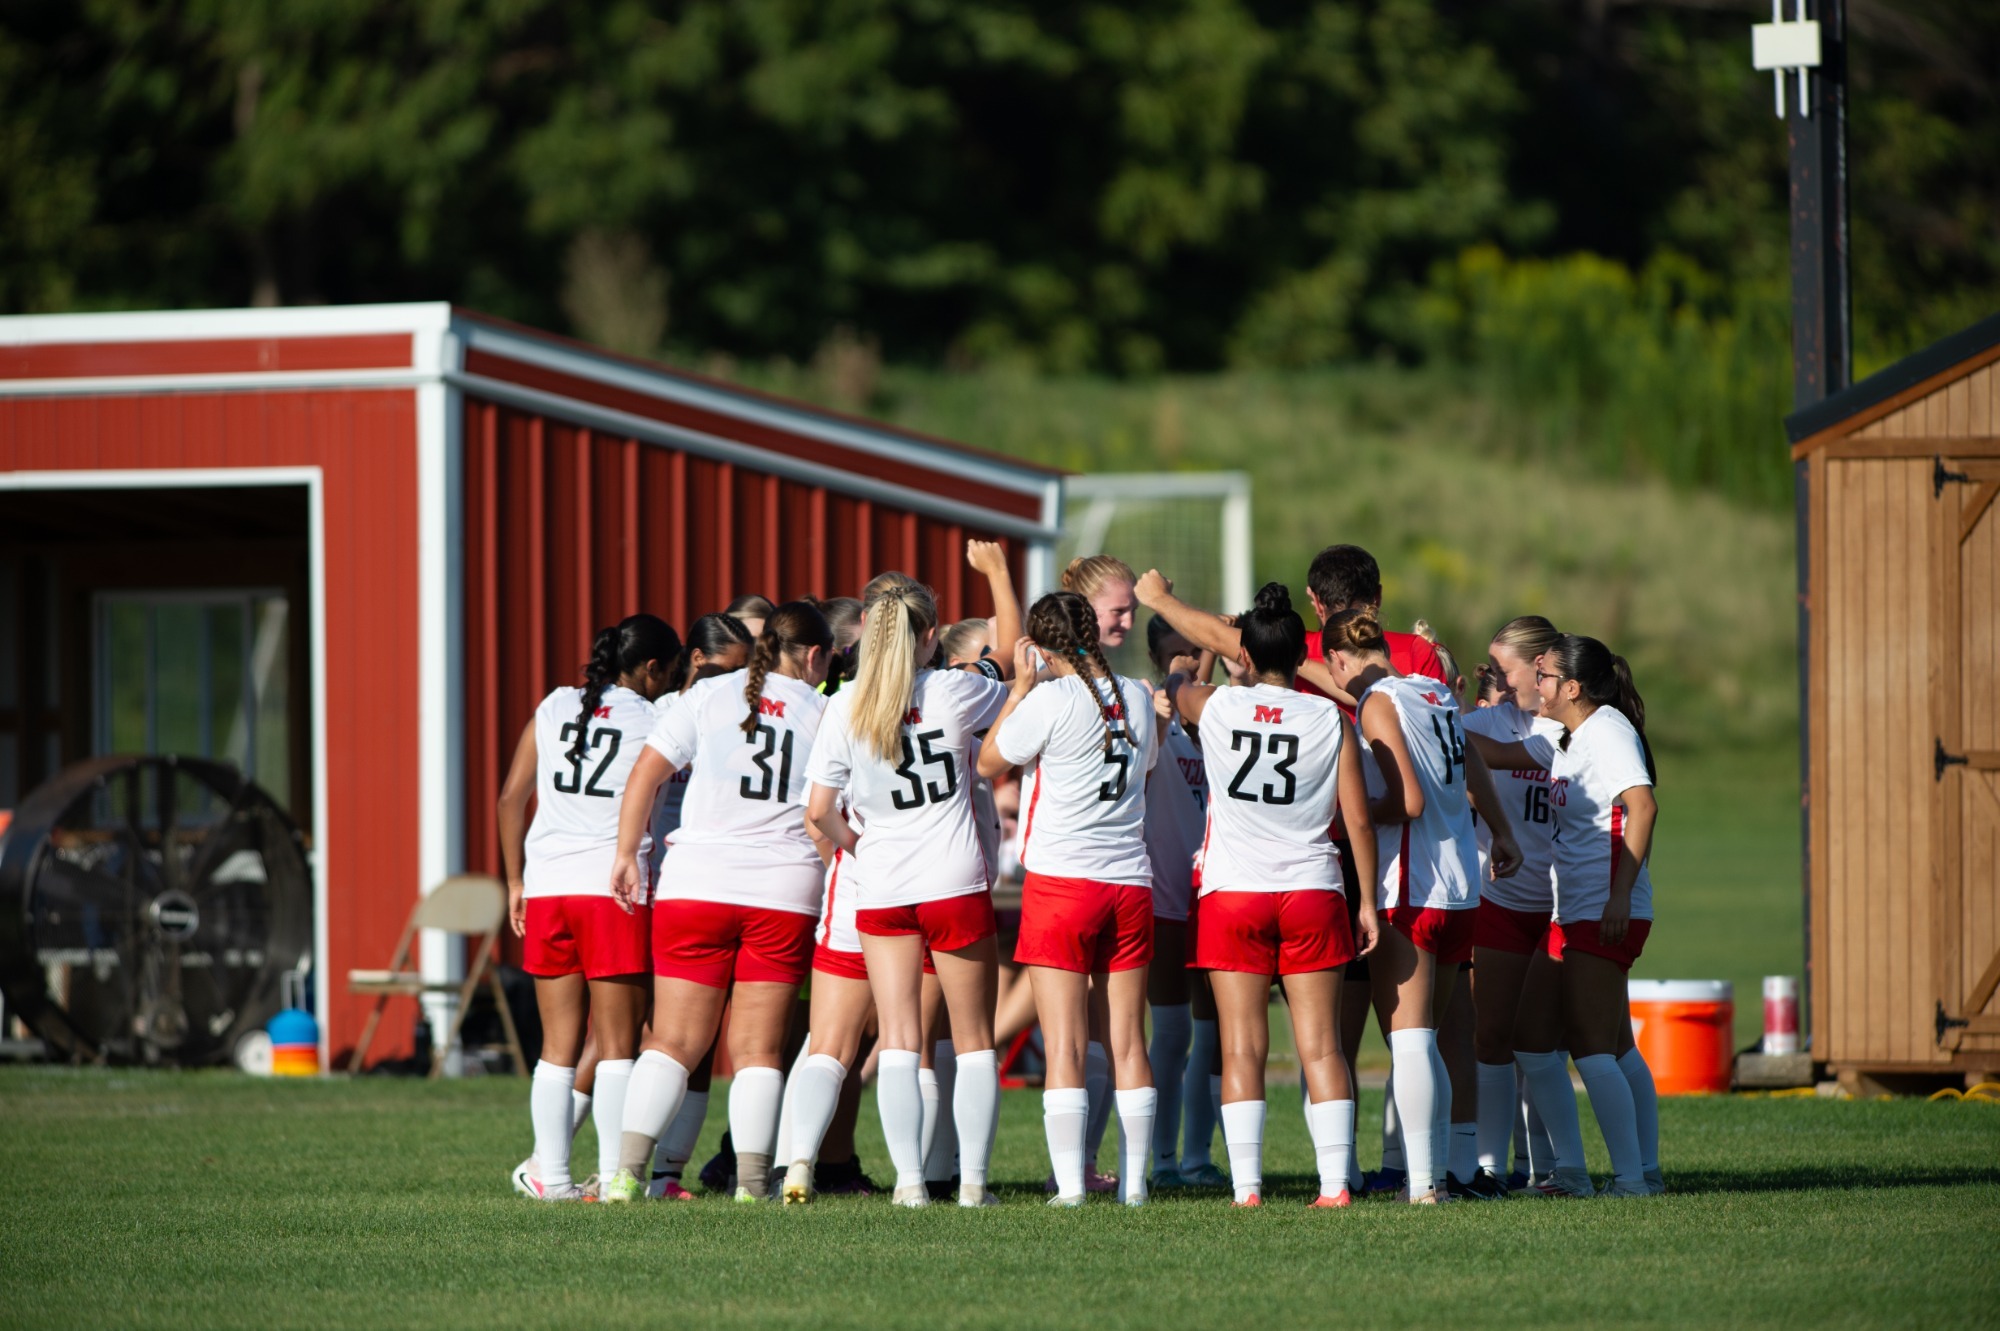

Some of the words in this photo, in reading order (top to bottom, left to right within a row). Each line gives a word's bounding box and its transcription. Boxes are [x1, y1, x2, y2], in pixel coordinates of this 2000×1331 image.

[758, 696, 786, 718] M
[1253, 705, 1283, 724] M
[554, 722, 622, 798] 32
[740, 722, 794, 803] 31
[891, 728, 957, 810] 35
[1099, 730, 1129, 801] 5
[1228, 729, 1299, 805] 23
[1431, 710, 1465, 785] 14
[1524, 785, 1549, 824] 16
